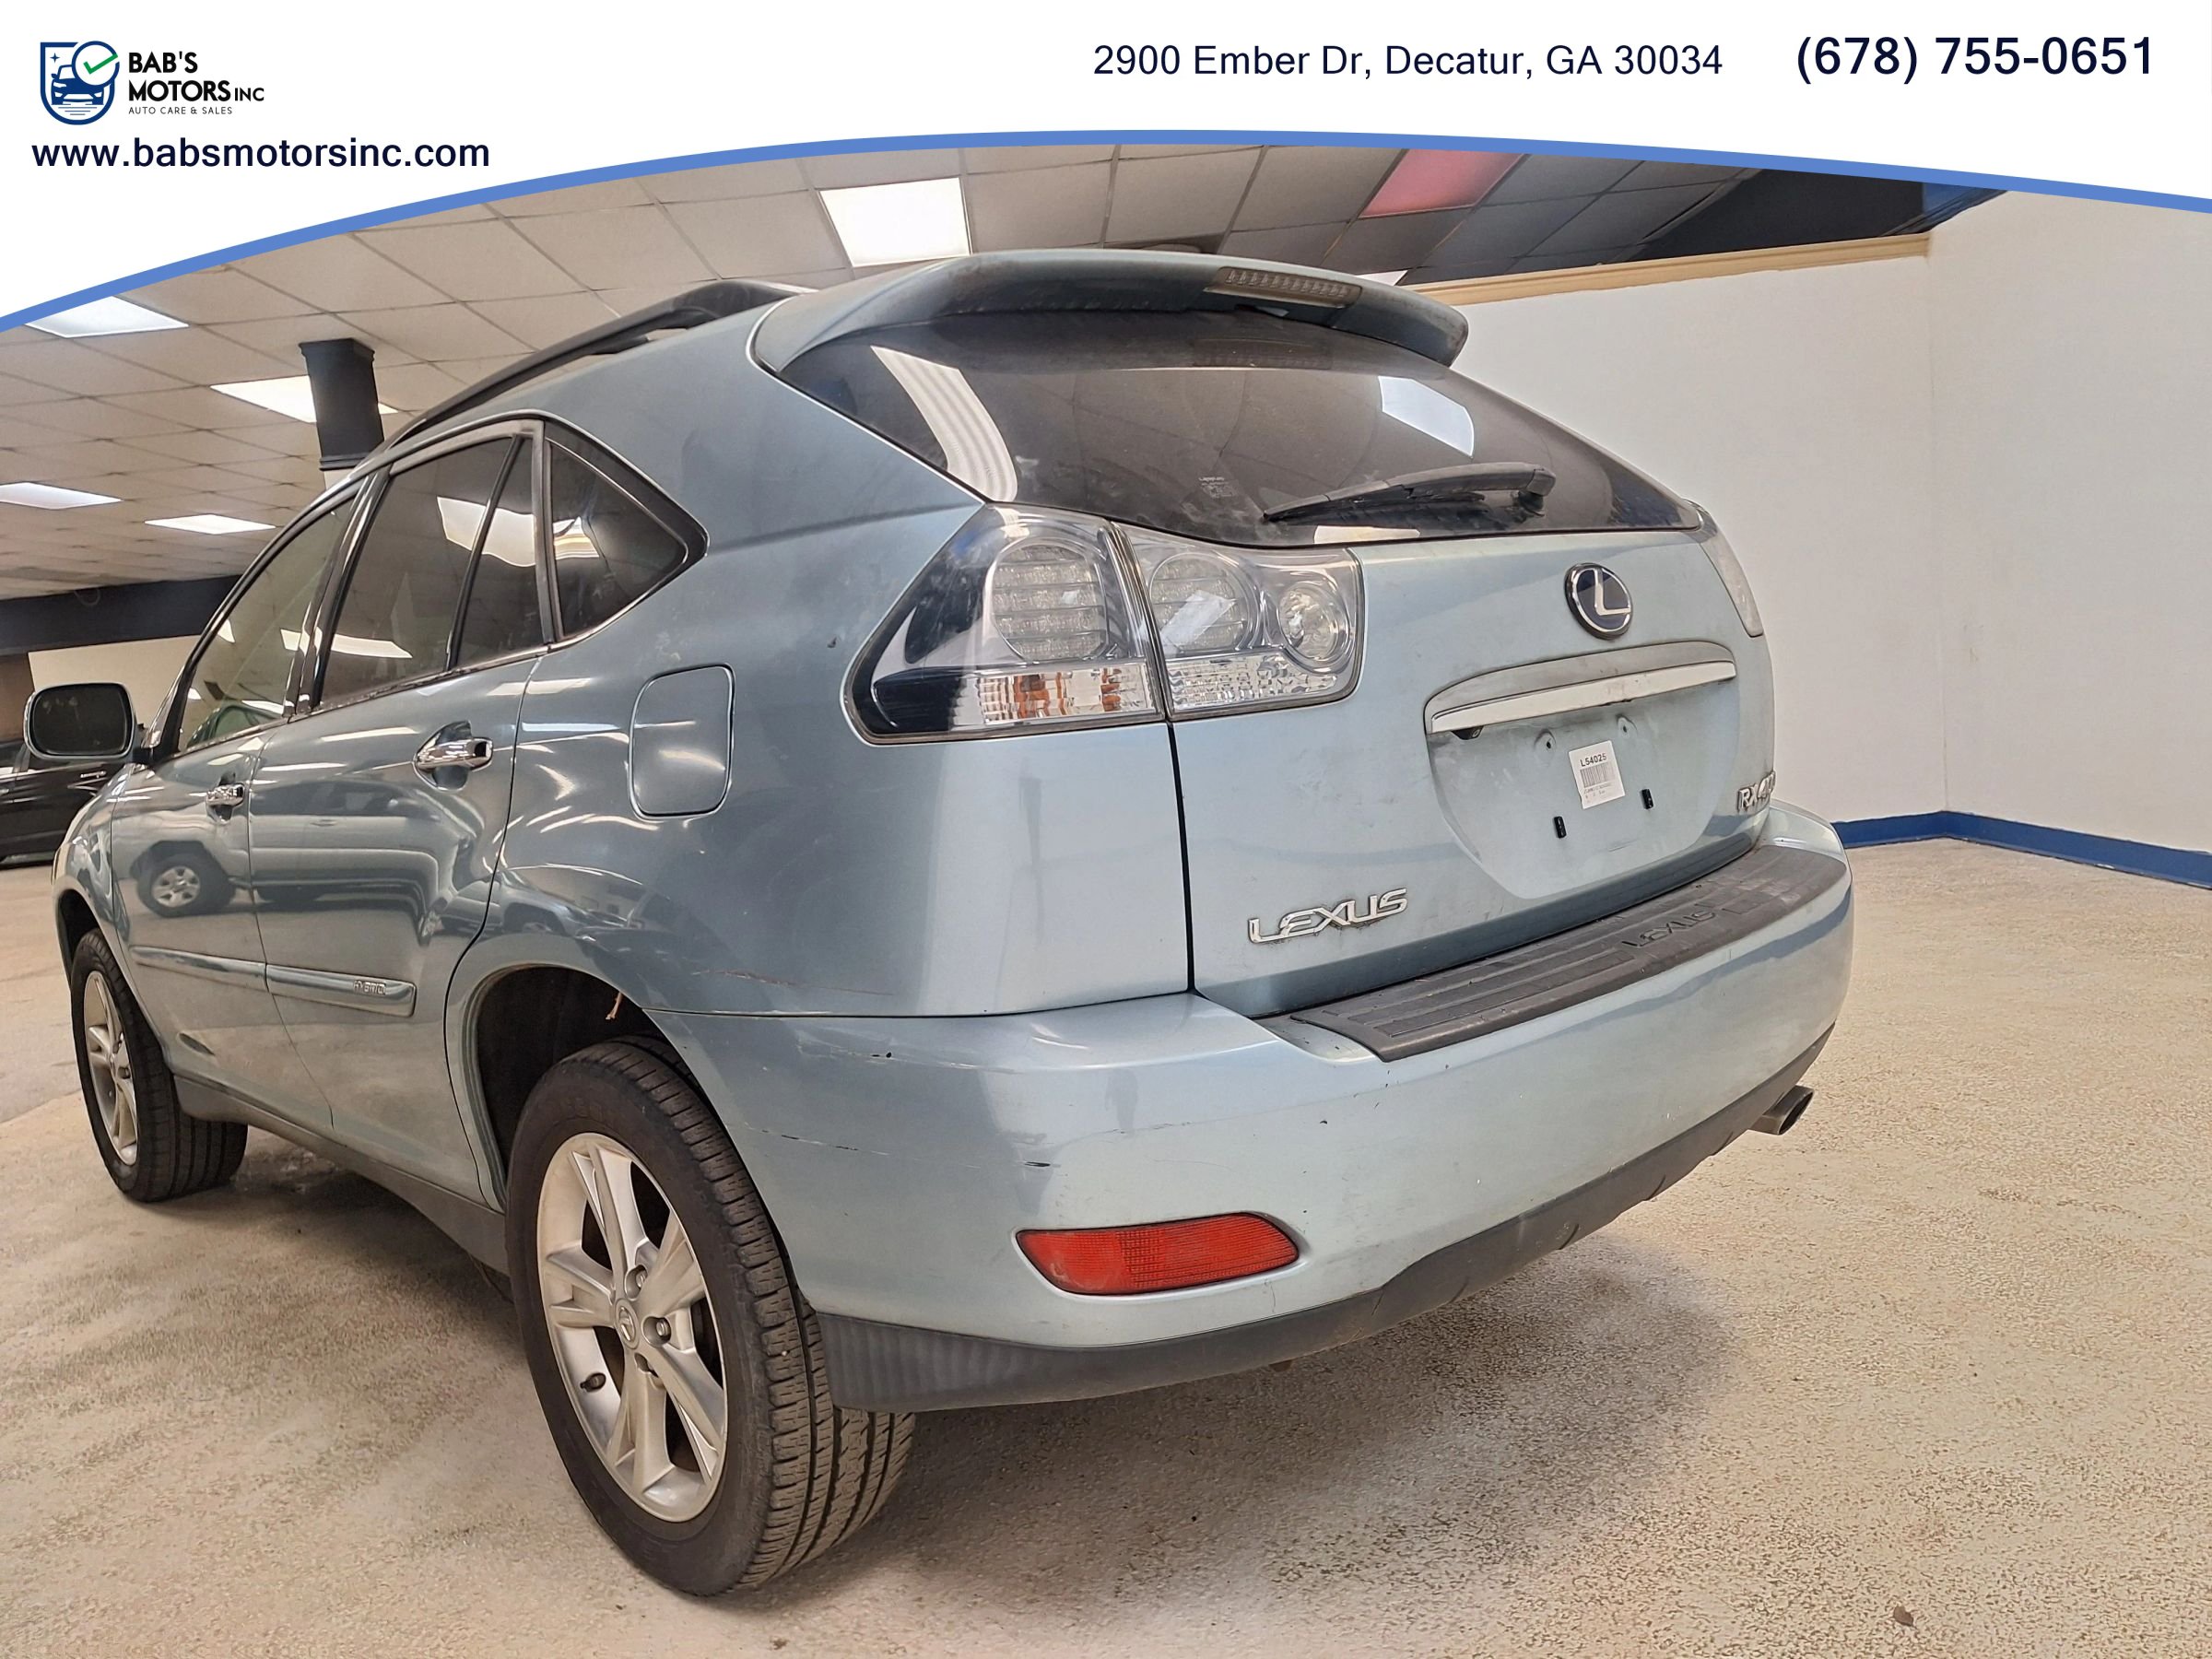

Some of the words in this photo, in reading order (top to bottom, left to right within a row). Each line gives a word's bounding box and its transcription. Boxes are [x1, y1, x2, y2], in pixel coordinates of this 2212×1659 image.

[1579, 752, 1607, 767] L54025
[1247, 887, 1408, 944] LEXUS
[1619, 911, 1717, 948] LEXUS
